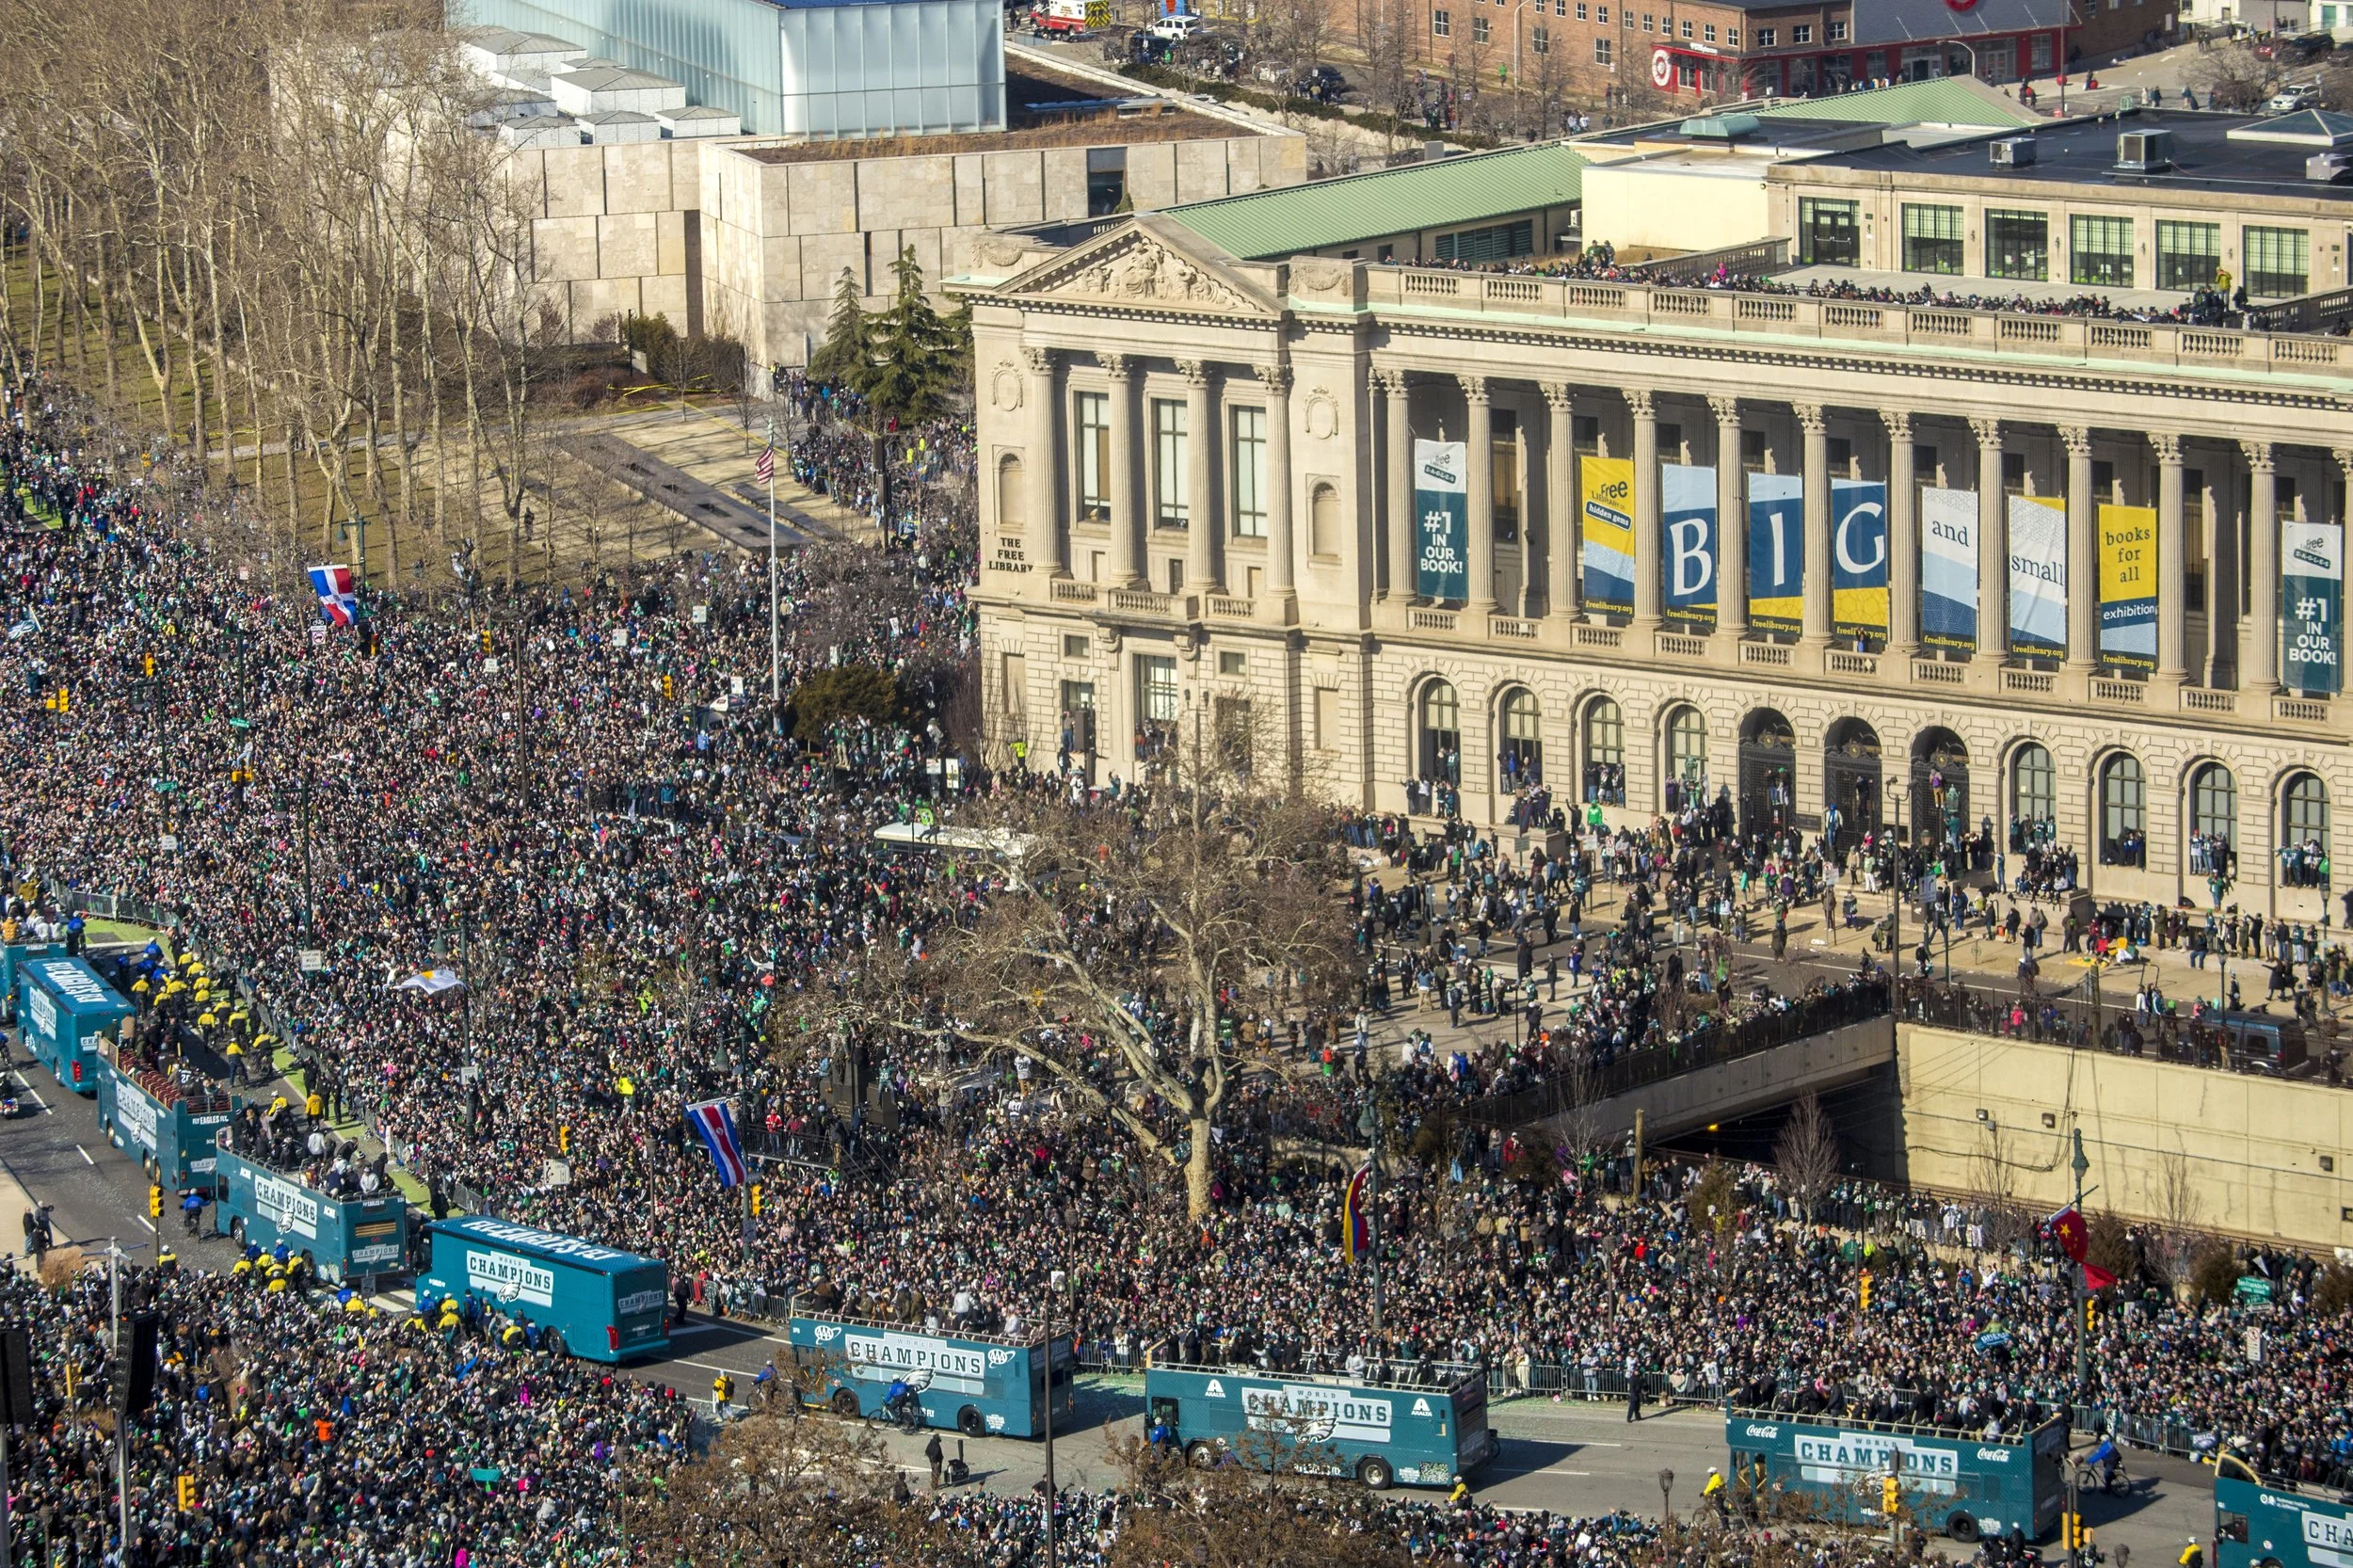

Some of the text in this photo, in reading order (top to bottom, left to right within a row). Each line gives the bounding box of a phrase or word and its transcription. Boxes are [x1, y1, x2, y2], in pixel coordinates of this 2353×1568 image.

[1601, 481, 1627, 499] Free
[1423, 511, 1451, 534] #1
[1589, 504, 1628, 526] hidden gems
[1433, 534, 1447, 547] IN
[1931, 520, 1970, 547] and
[2105, 526, 2151, 546] books
[1000, 537, 1021, 548] THE
[998, 550, 1024, 561] FREE
[1425, 546, 1455, 560] OUR
[2118, 546, 2141, 563] for
[989, 561, 1033, 573] LIBRARY
[1420, 558, 1463, 574] BOOK!
[2011, 554, 2064, 586] small
[2120, 566, 2140, 583] all
[1586, 600, 1633, 614] freelibrary.org
[2103, 603, 2154, 620] exhibition
[2295, 597, 2329, 622] #1
[1667, 609, 1715, 623] freelibrary.org
[1753, 619, 1801, 633] freelibrary.org
[2306, 621, 2322, 635] IN
[1924, 635, 1975, 650] freelibrary.org
[2297, 634, 2329, 651] OUR
[2012, 645, 2063, 659] freelibrary.org
[2288, 648, 2337, 665] BOOK!
[2103, 654, 2154, 669] freelibrary.org
[200, 1115, 219, 1125] EAGLES
[256, 1182, 315, 1221] CHAMPIONS
[353, 1245, 398, 1257] CHAMPIONS
[470, 1257, 551, 1289] CHAMPIONS
[816, 1326, 834, 1340] AAA
[898, 1338, 934, 1349] WORLD
[851, 1341, 981, 1374] CHAMPIONS
[988, 1349, 1007, 1365] AAA
[1297, 1389, 1337, 1399] WORLD
[926, 1409, 935, 1417] FLY
[1855, 1438, 1897, 1448] WORLD
[1801, 1442, 1952, 1474] CHAMPONS
